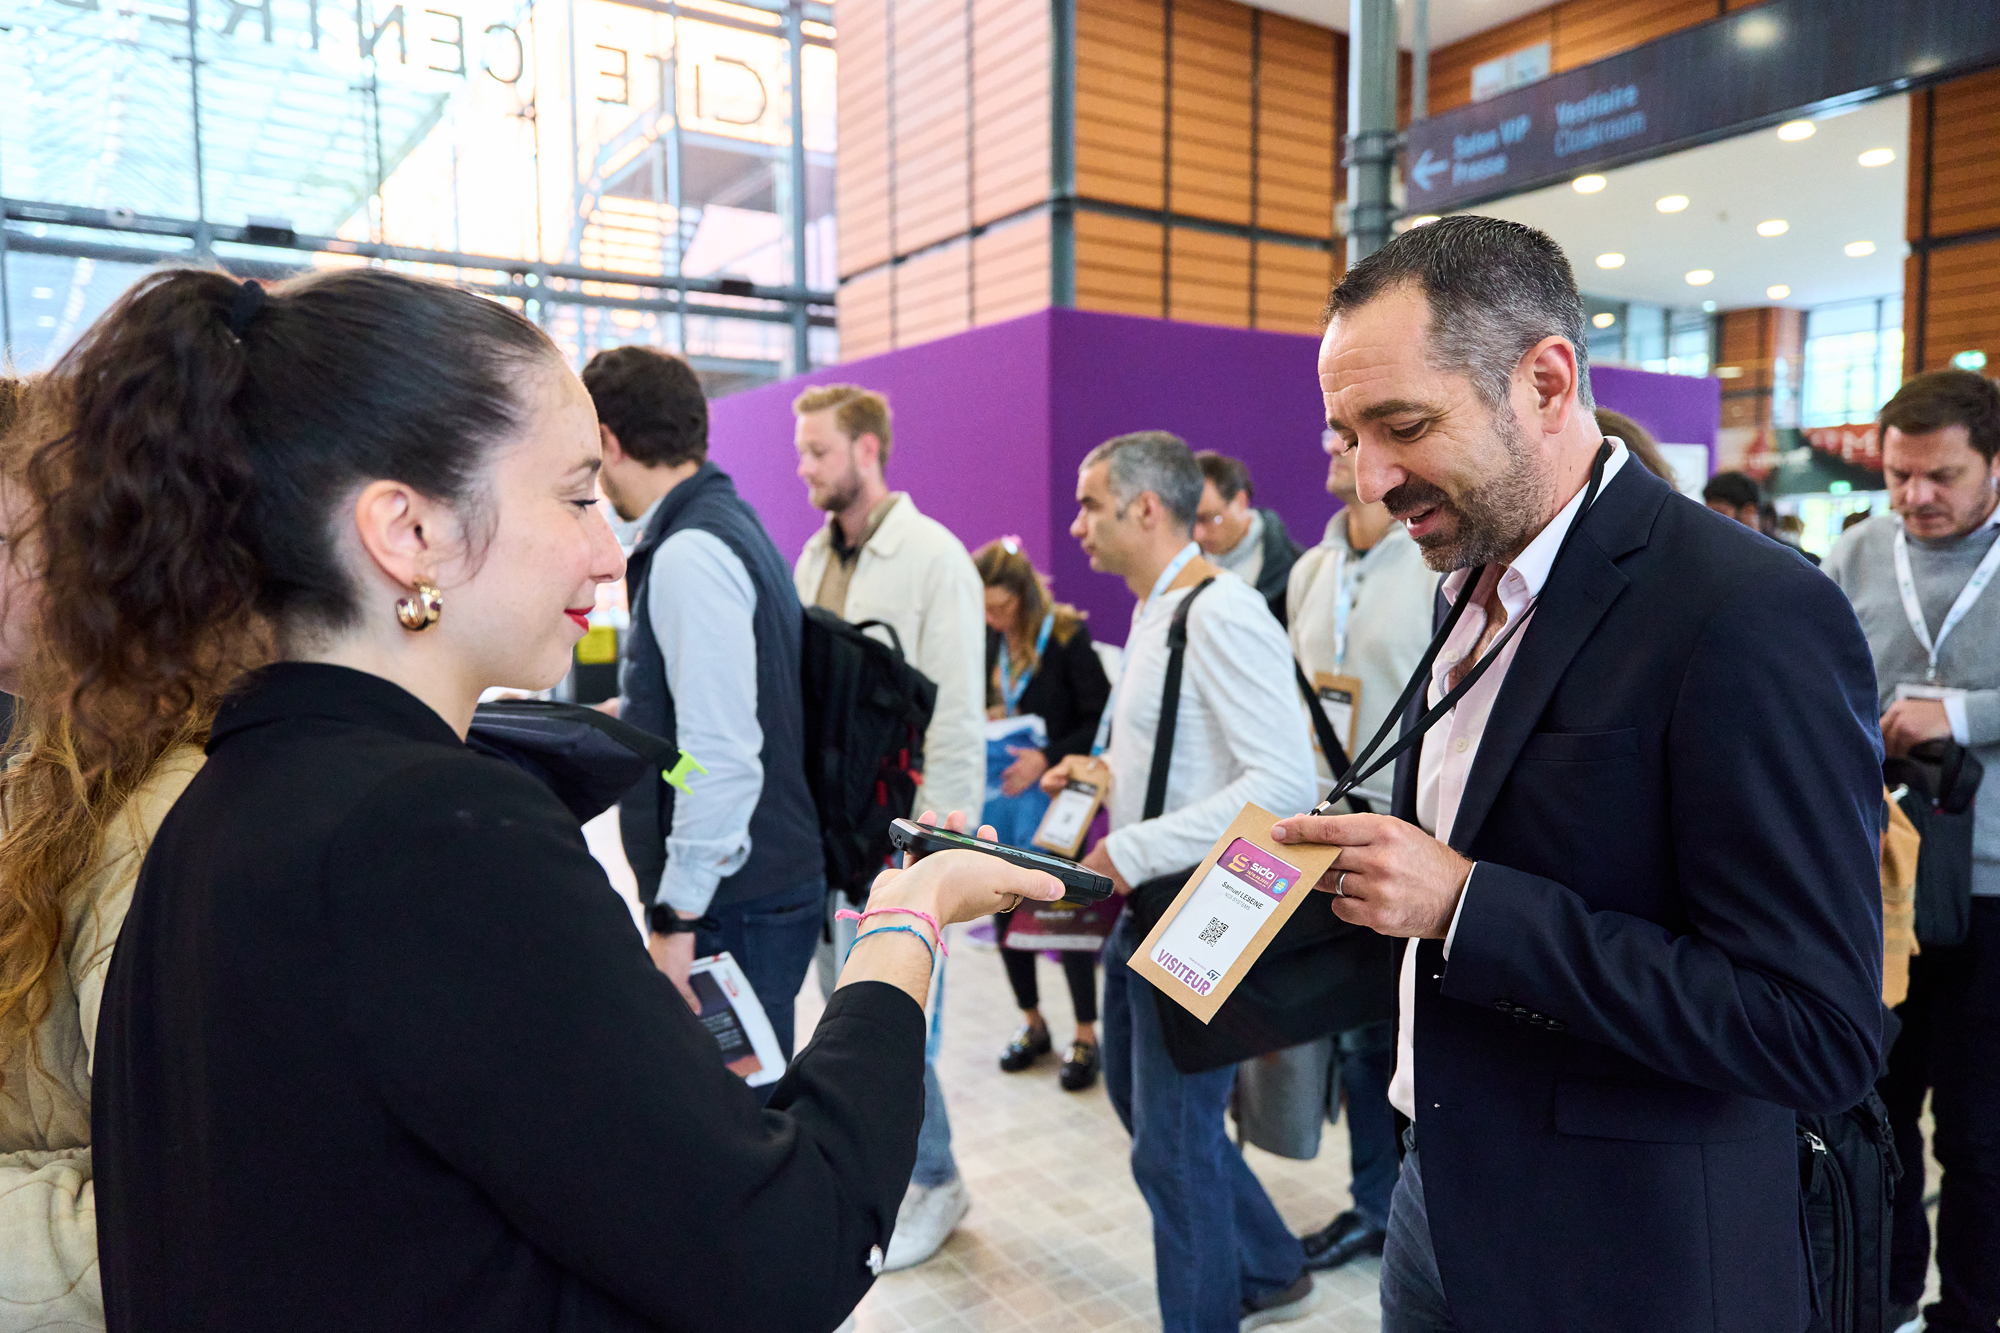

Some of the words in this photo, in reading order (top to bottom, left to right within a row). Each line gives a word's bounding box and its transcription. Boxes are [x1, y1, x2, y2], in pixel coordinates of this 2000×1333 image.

[1555, 84, 1640, 126] Vestiaire
[1499, 113, 1532, 145] VIP
[1554, 111, 1647, 158] Cloakroom
[1221, 881, 1242, 896] Samuel
[1239, 892, 1264, 910] LESEINE
[1156, 949, 1212, 996] VISITEUR
